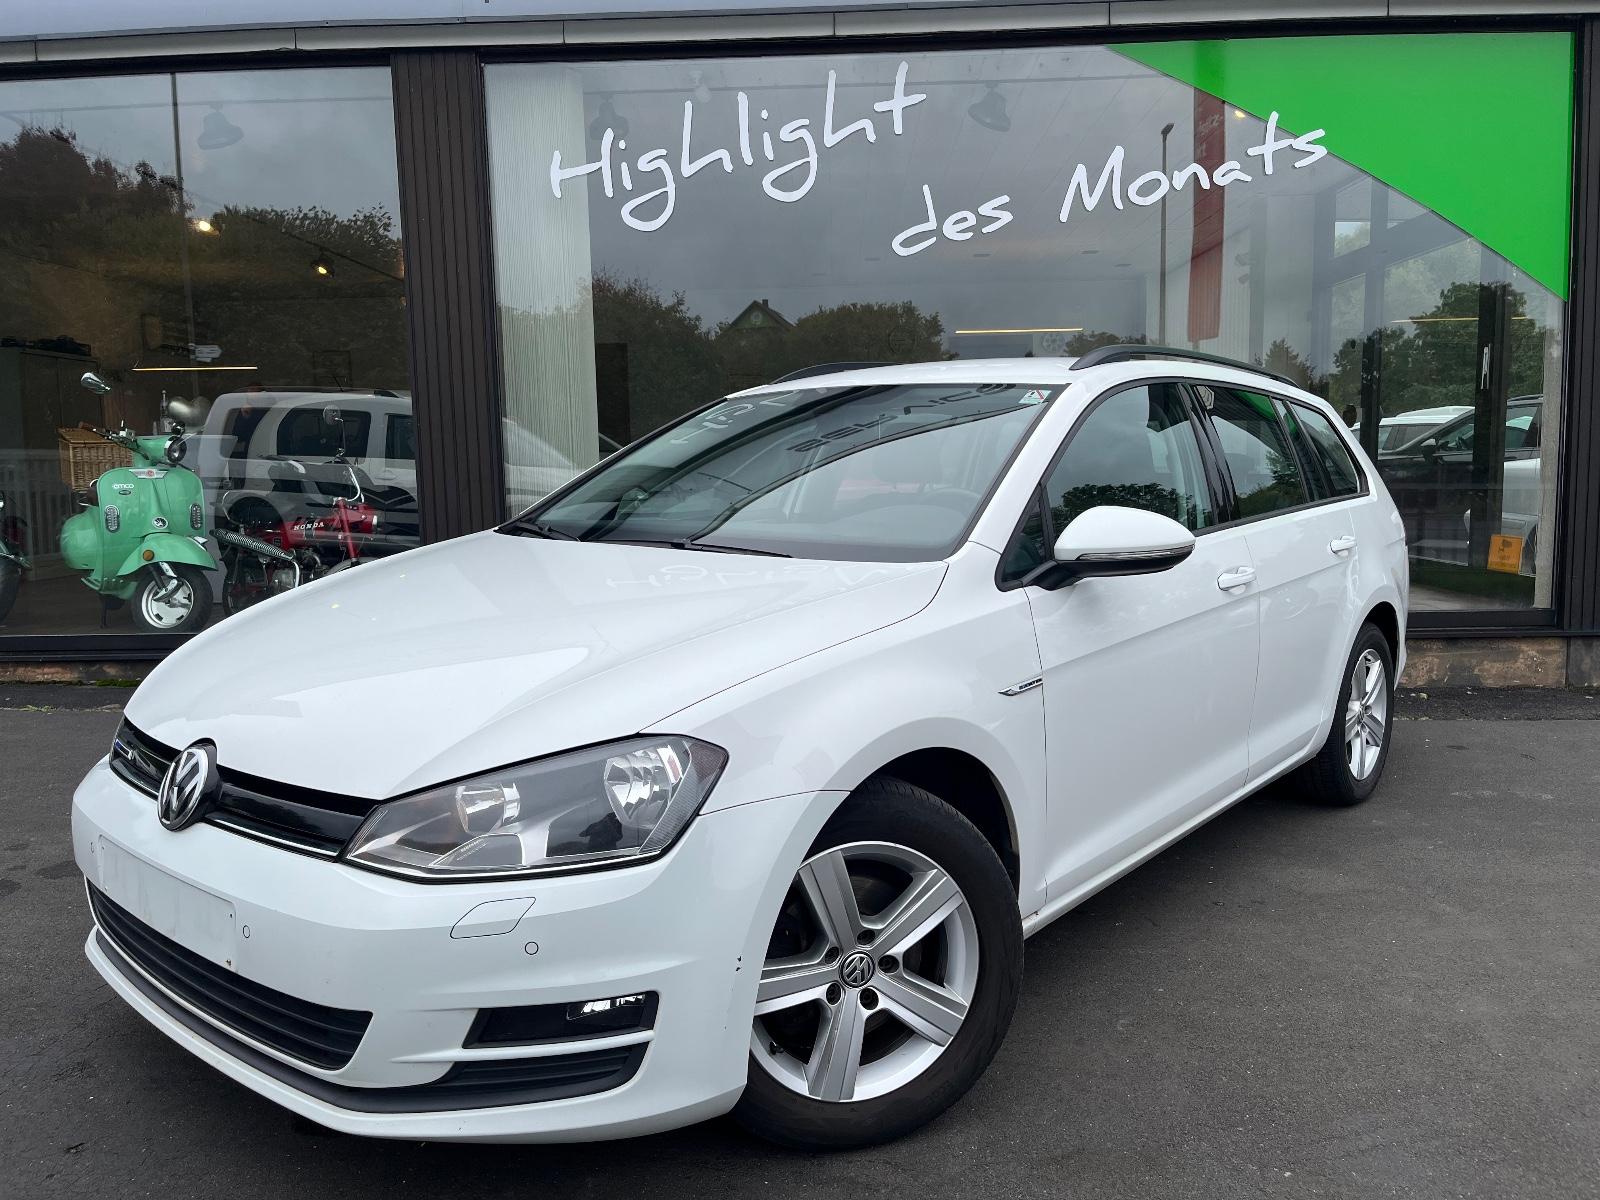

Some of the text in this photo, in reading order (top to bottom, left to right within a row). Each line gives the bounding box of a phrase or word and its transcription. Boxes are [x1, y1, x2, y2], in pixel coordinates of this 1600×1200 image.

[551, 61, 927, 232] Highlight
[891, 184, 1014, 256] des
[1059, 111, 1328, 223] Monats
[293, 521, 325, 531] HONDA
